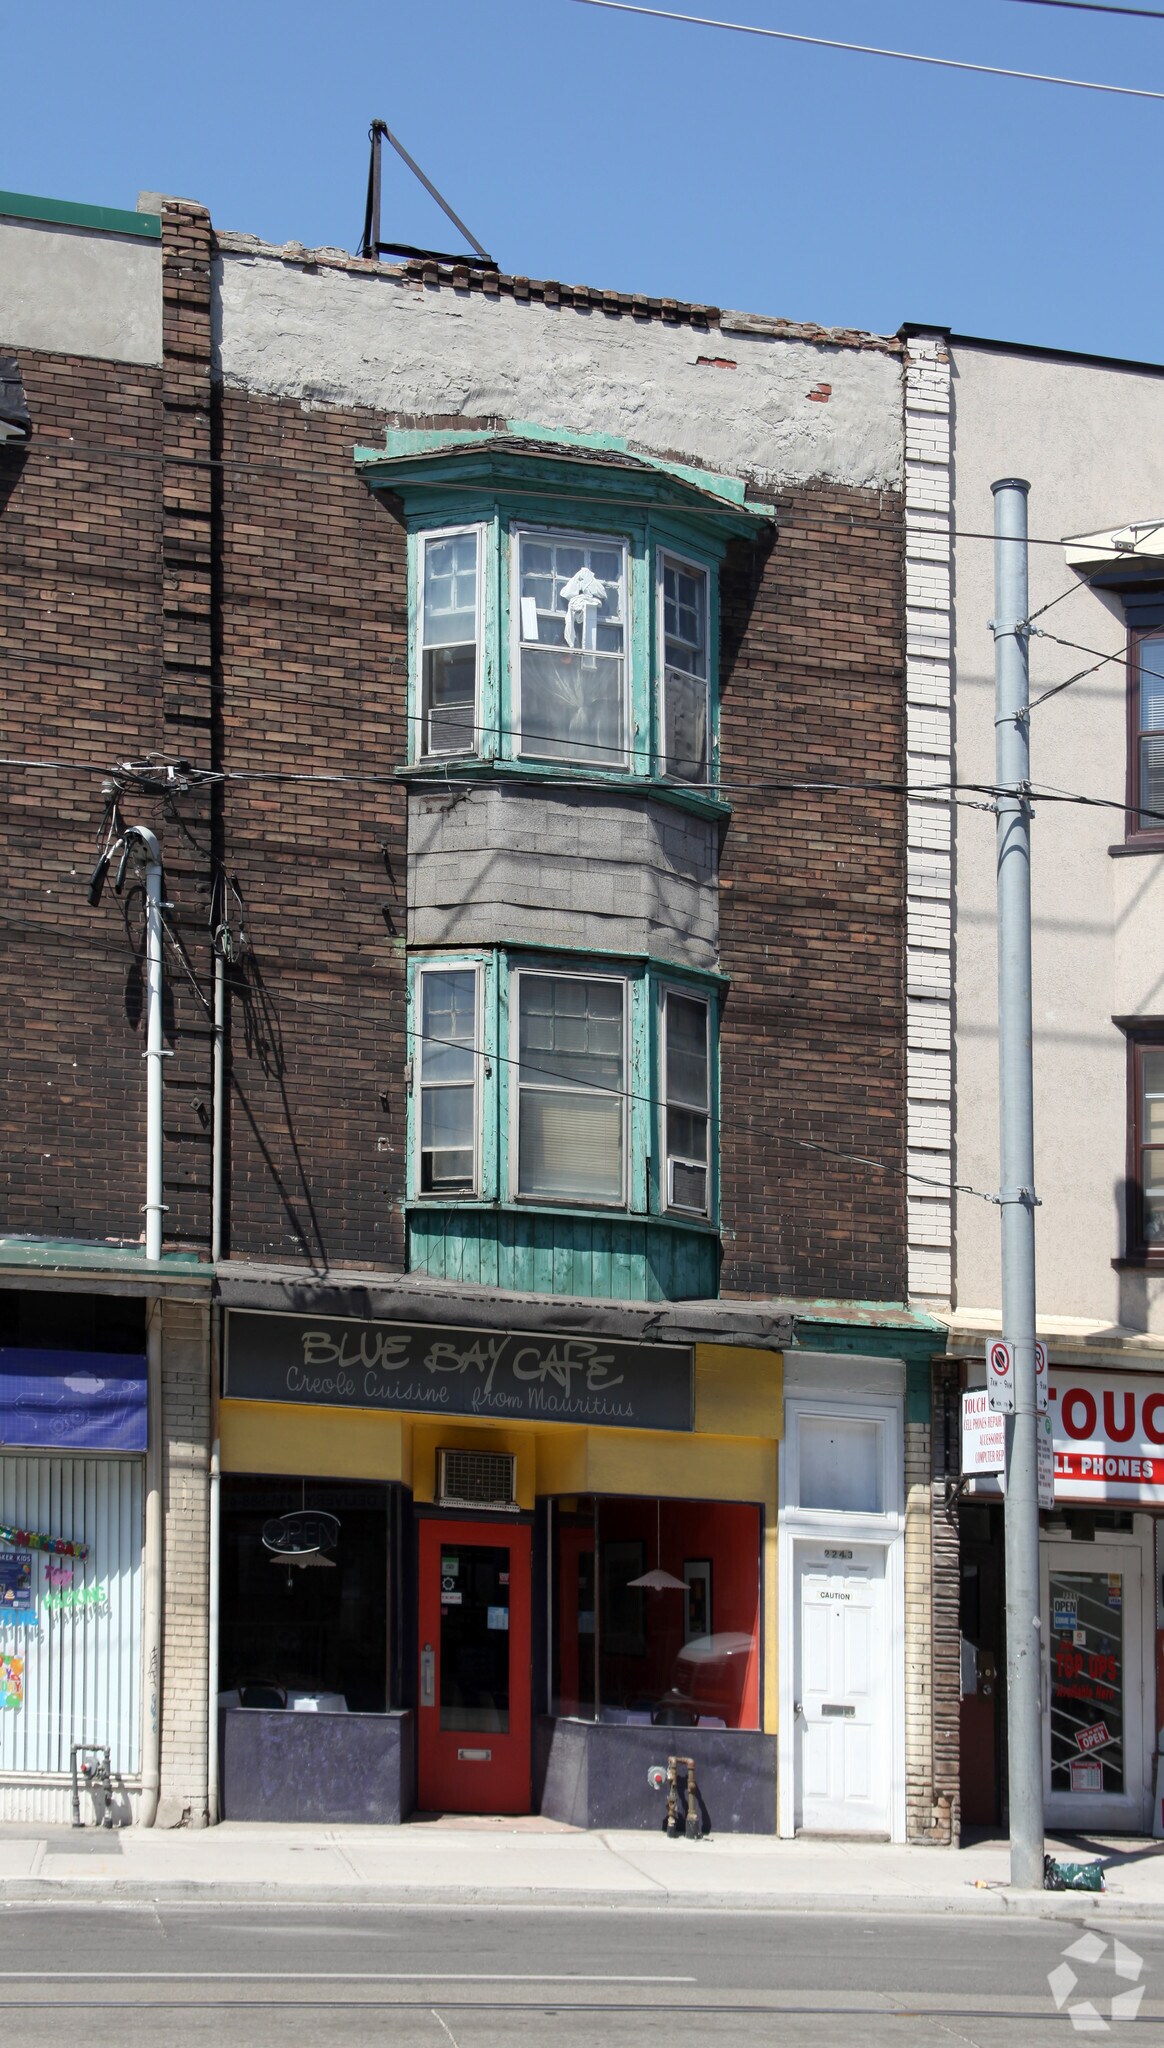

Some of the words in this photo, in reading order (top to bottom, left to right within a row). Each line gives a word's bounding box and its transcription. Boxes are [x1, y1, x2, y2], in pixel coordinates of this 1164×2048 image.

[301, 1331, 412, 1370] BLUE
[424, 1337, 511, 1393] BAY
[513, 1341, 624, 1398] CAFE
[286, 1365, 356, 1397] Creole
[364, 1368, 450, 1404] Cuisine
[471, 1386, 523, 1412] from
[528, 1386, 635, 1417] Mauritius
[964, 1396, 986, 1415] TOUCH
[1048, 1387, 1164, 1445] OUC
[995, 1449, 1004, 1462] REP
[1054, 1455, 1073, 1474] LL
[1081, 1456, 1153, 1479] PHONES
[42, 1585, 106, 1611] HACKING
[820, 1591, 851, 1600] CAUTION
[1055, 1600, 1077, 1613] OPEN
[1055, 1652, 1083, 1680] TOP
[1088, 1655, 1117, 1681] UPS
[1082, 1731, 1105, 1748] OPEN
